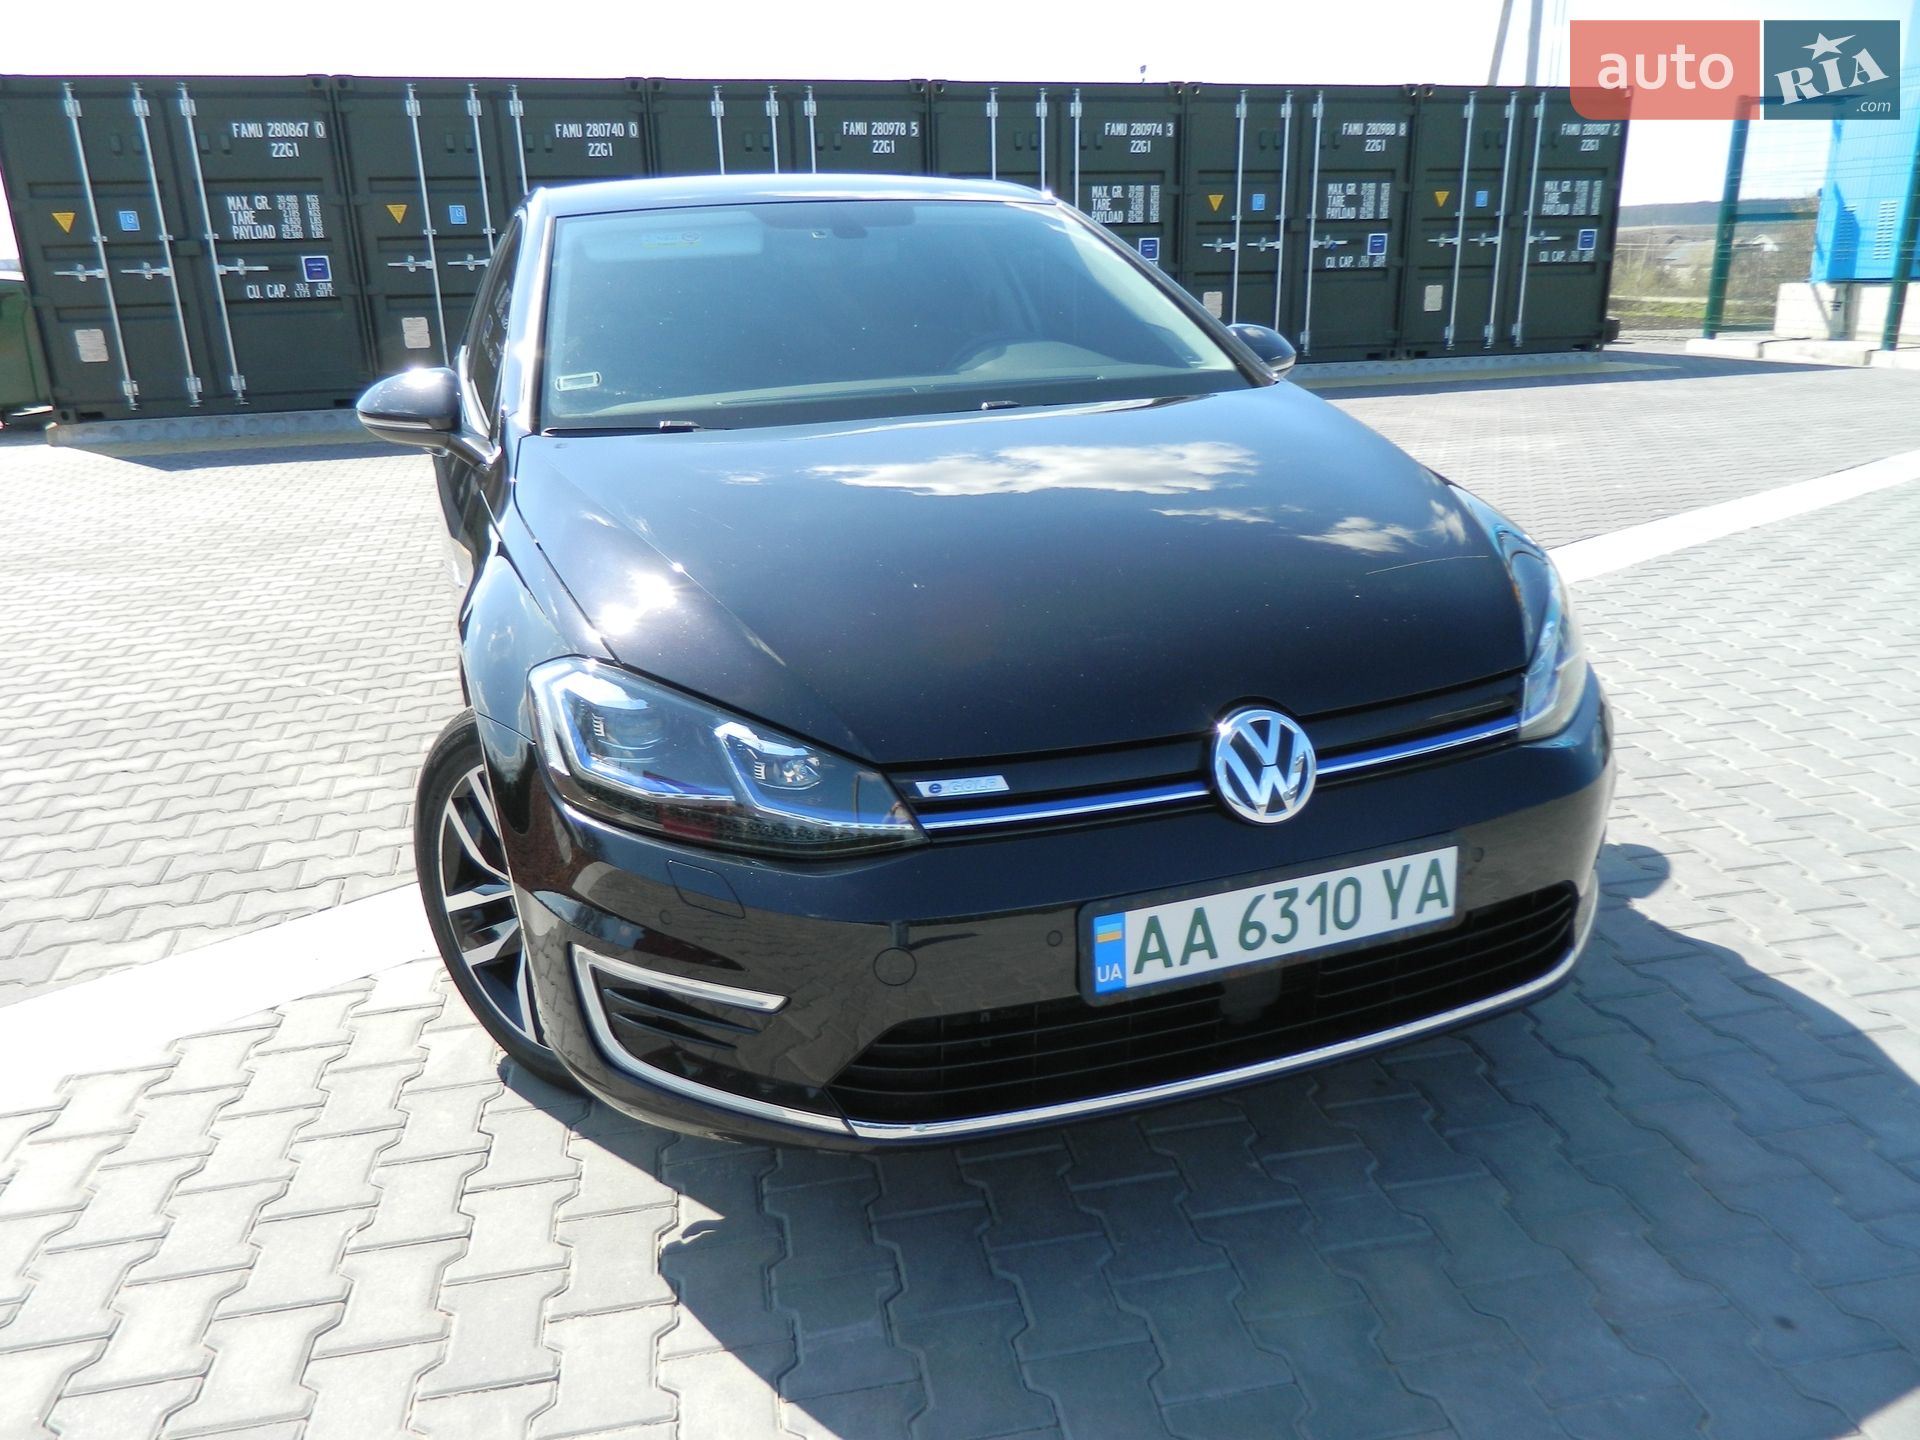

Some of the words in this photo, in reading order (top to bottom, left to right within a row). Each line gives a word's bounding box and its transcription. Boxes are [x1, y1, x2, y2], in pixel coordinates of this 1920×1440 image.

[232, 123, 263, 138] FAMU
[267, 122, 309, 138] 280867
[315, 122, 326, 138] 0
[555, 123, 582, 138] FAMU
[586, 122, 625, 137] 280740
[629, 122, 638, 138] 0
[843, 121, 868, 136] FAMU
[871, 122, 906, 136] 280978
[910, 121, 919, 137] 5
[1104, 122, 1128, 136] FAMU
[1130, 122, 1163, 136] 280974
[1166, 122, 1174, 137] 3
[271, 142, 299, 158] 22G1
[588, 142, 613, 157] 22G1
[872, 140, 895, 154] 22G1
[1130, 140, 1152, 153] 22G1
[227, 195, 253, 211] MAX.
[254, 195, 272, 210] GR.
[1092, 199, 1111, 211] TARE
[230, 211, 258, 225] TARE
[1091, 210, 1124, 223] PAYLOAD
[232, 225, 276, 239] PAYLOAD
[247, 285, 263, 298] CU.
[266, 284, 290, 298] CAP.
[1133, 906, 1218, 975] AA
[1237, 875, 1363, 952] 6310
[1382, 857, 1449, 921] YA
[1097, 962, 1123, 983] UA
